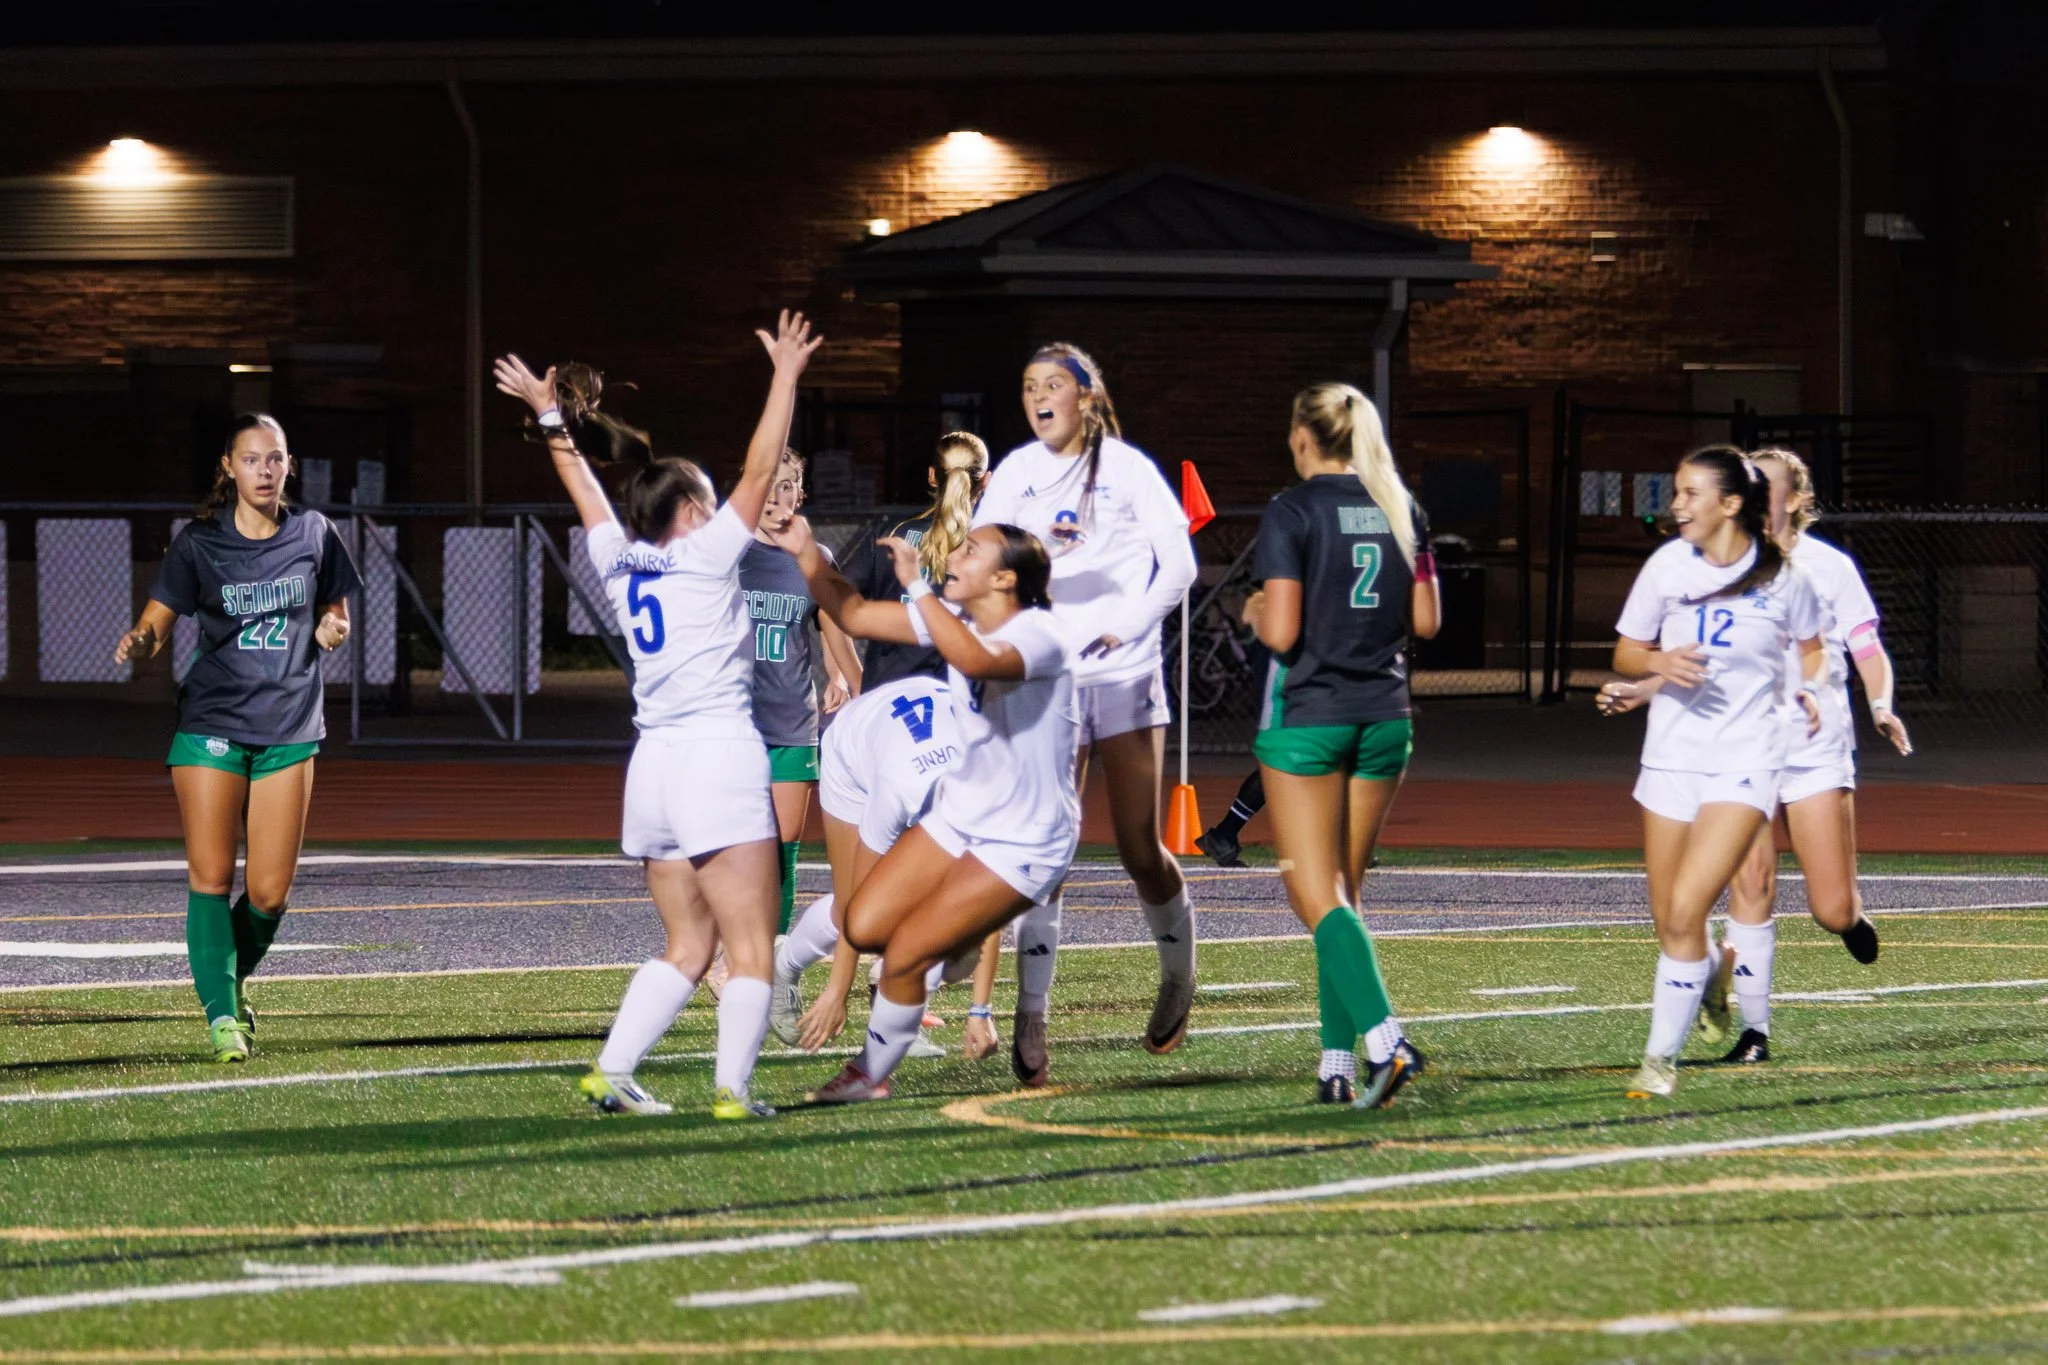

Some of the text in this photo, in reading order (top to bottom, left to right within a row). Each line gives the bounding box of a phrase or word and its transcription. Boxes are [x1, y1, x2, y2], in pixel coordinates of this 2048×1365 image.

[222, 575, 306, 616] SCIOTO
[1351, 543, 1381, 608] 2
[238, 612, 288, 650] 22
[627, 571, 665, 655] 5
[1695, 605, 1734, 647] 12
[755, 623, 787, 662] 10
[890, 695, 933, 744] 4
